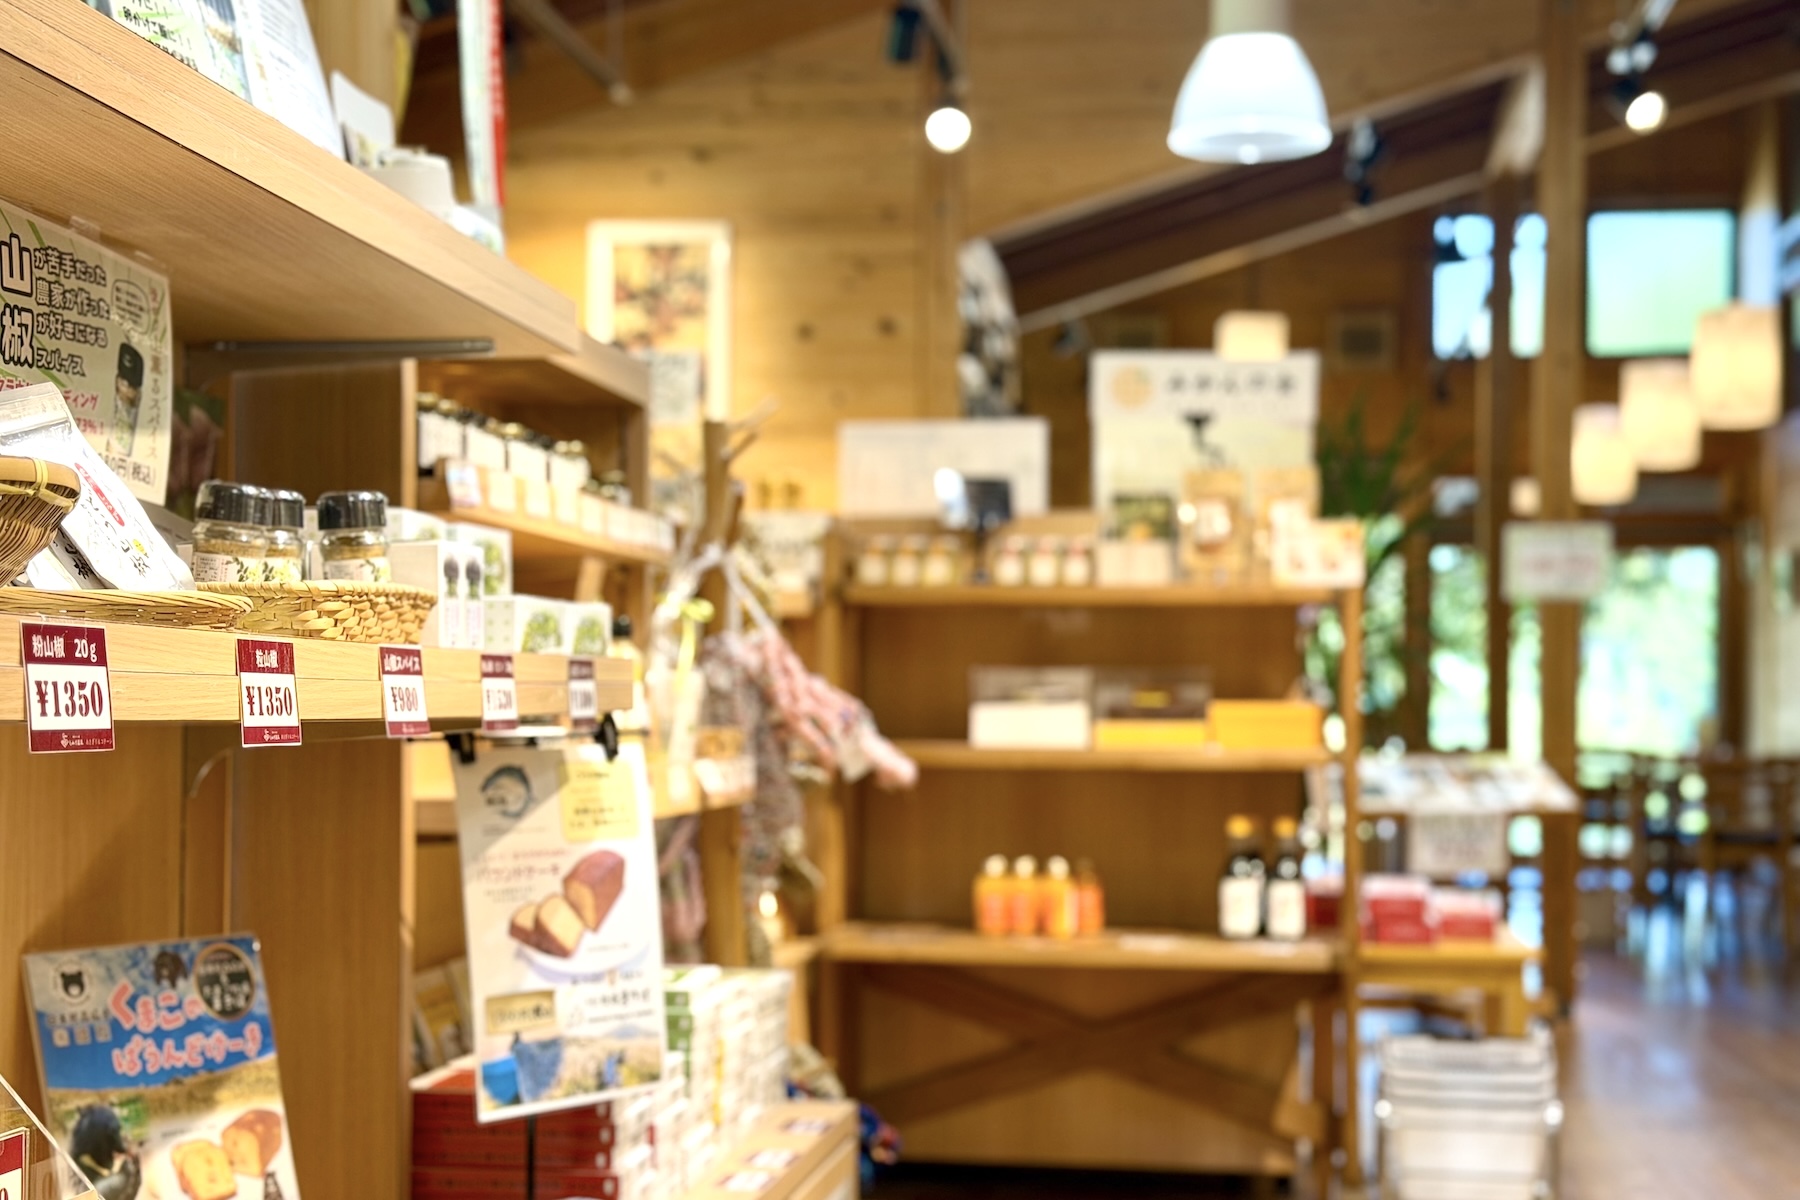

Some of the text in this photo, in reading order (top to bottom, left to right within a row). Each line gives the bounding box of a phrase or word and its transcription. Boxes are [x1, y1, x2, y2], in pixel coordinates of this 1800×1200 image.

[33, 246, 107, 287] が苦手だった
[35, 276, 111, 320] 農家が作った
[36, 311, 108, 349] が好きになる
[36, 346, 87, 378] スパイス
[31, 634, 98, 663] 粉山椒 20g
[35, 680, 104, 718] ¥1350
[245, 686, 293, 717] ¥1350
[390, 686, 419, 712] ¥980
